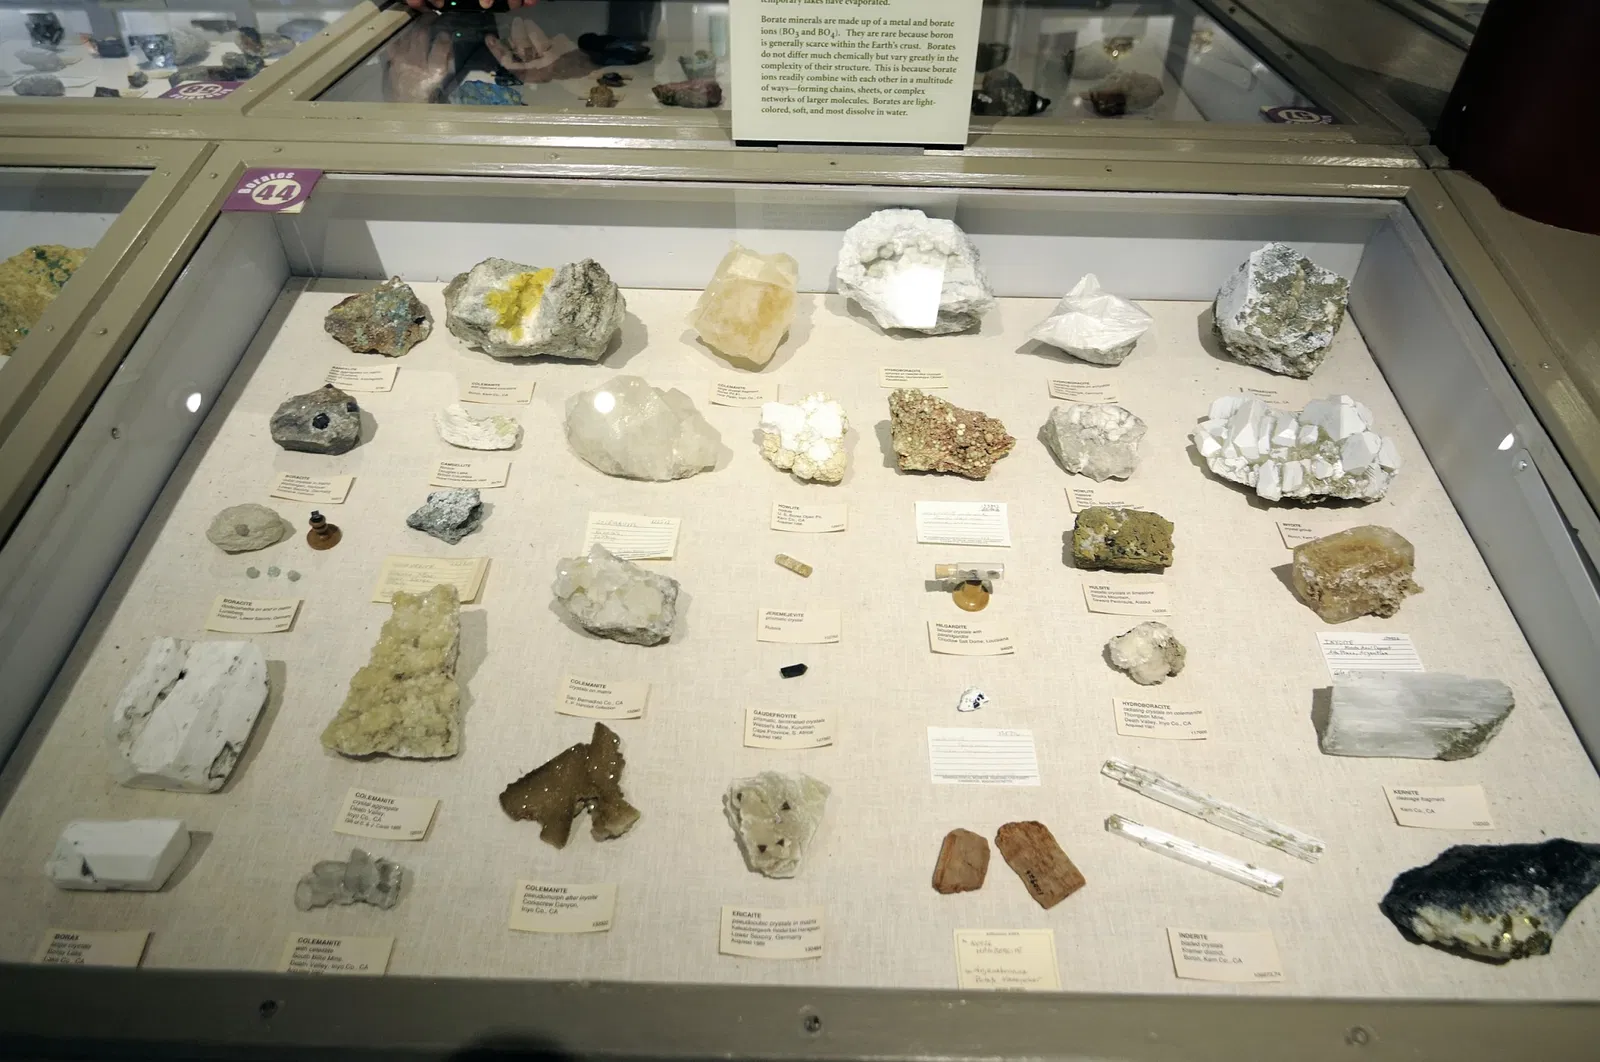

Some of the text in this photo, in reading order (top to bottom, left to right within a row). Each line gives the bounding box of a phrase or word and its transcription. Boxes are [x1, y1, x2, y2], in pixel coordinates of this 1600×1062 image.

[761, 15, 786, 23] Borate
[788, 16, 822, 24] minerals
[861, 19, 871, 27] up
[873, 17, 882, 25] of
[889, 18, 911, 26] metal
[929, 19, 955, 27] borate
[761, 27, 777, 35] ions
[801, 28, 816, 36] and
[846, 29, 865, 38] They
[898, 29, 928, 38] because
[930, 30, 954, 39] boron
[769, 39, 803, 48] generally
[830, 40, 856, 48] within
[858, 41, 870, 49] the
[872, 41, 898, 49] Earth's
[927, 42, 956, 50] Borates
[761, 50, 771, 58] do
[787, 51, 809, 59] differ
[833, 52, 873, 62] chemically
[909, 54, 935, 63] greatly
[947, 54, 959, 62] the
[761, 62, 802, 72] complexity
[804, 62, 814, 70] of
[814, 63, 833, 71] their
[875, 64, 891, 72] This
[901, 64, 930, 73] because
[779, 73, 804, 83] readily
[806, 74, 839, 82] combine
[859, 75, 876, 83] each
[878, 75, 898, 83] other
[915, 76, 953, 84] multitude
[830, 86, 856, 94] chains,
[857, 86, 882, 94] sheets,
[894, 87, 925, 96] complex
[761, 95, 795, 103] networks
[806, 96, 829, 105] larger
[873, 97, 901, 105] Borates
[915, 98, 936, 107] light-
[761, 106, 791, 114] colored,
[238, 172, 295, 194] Borates
[255, 185, 297, 200] 44
[223, 598, 252, 606] BORACITE
[570, 679, 606, 689] COLEMANITE
[753, 710, 797, 719] GAUDEFROYITE
[355, 792, 395, 804] COLEMANITE
[525, 884, 568, 893] COLEMANITE
[297, 937, 342, 946] COLEMANITE
[1179, 932, 1208, 940] INDERITE
